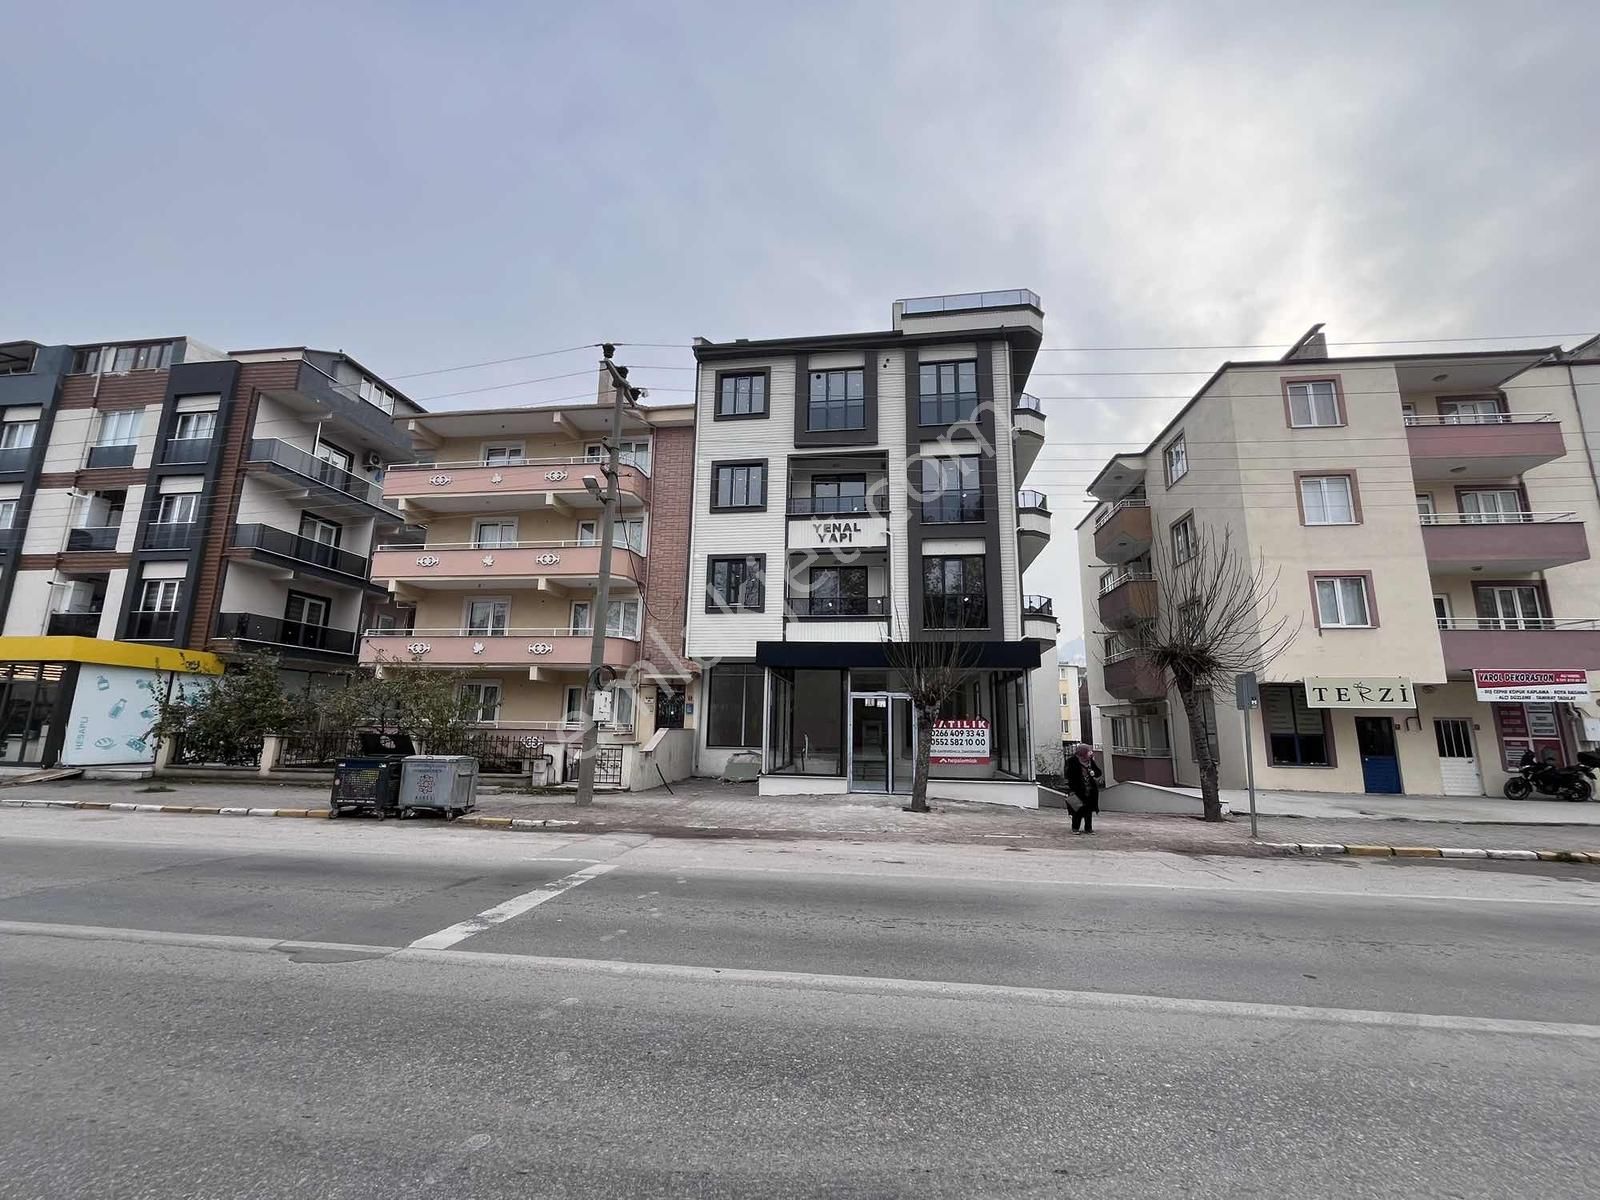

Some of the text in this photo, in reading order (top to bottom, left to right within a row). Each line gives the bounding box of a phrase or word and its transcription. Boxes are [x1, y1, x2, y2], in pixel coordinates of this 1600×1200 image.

[812, 522, 861, 533] YENAL
[818, 533, 852, 543] YAPI
[1478, 673, 1503, 683] VAROL
[1505, 672, 1555, 683] DEKORASYON
[931, 738, 986, 746] 0552 582 10 00
